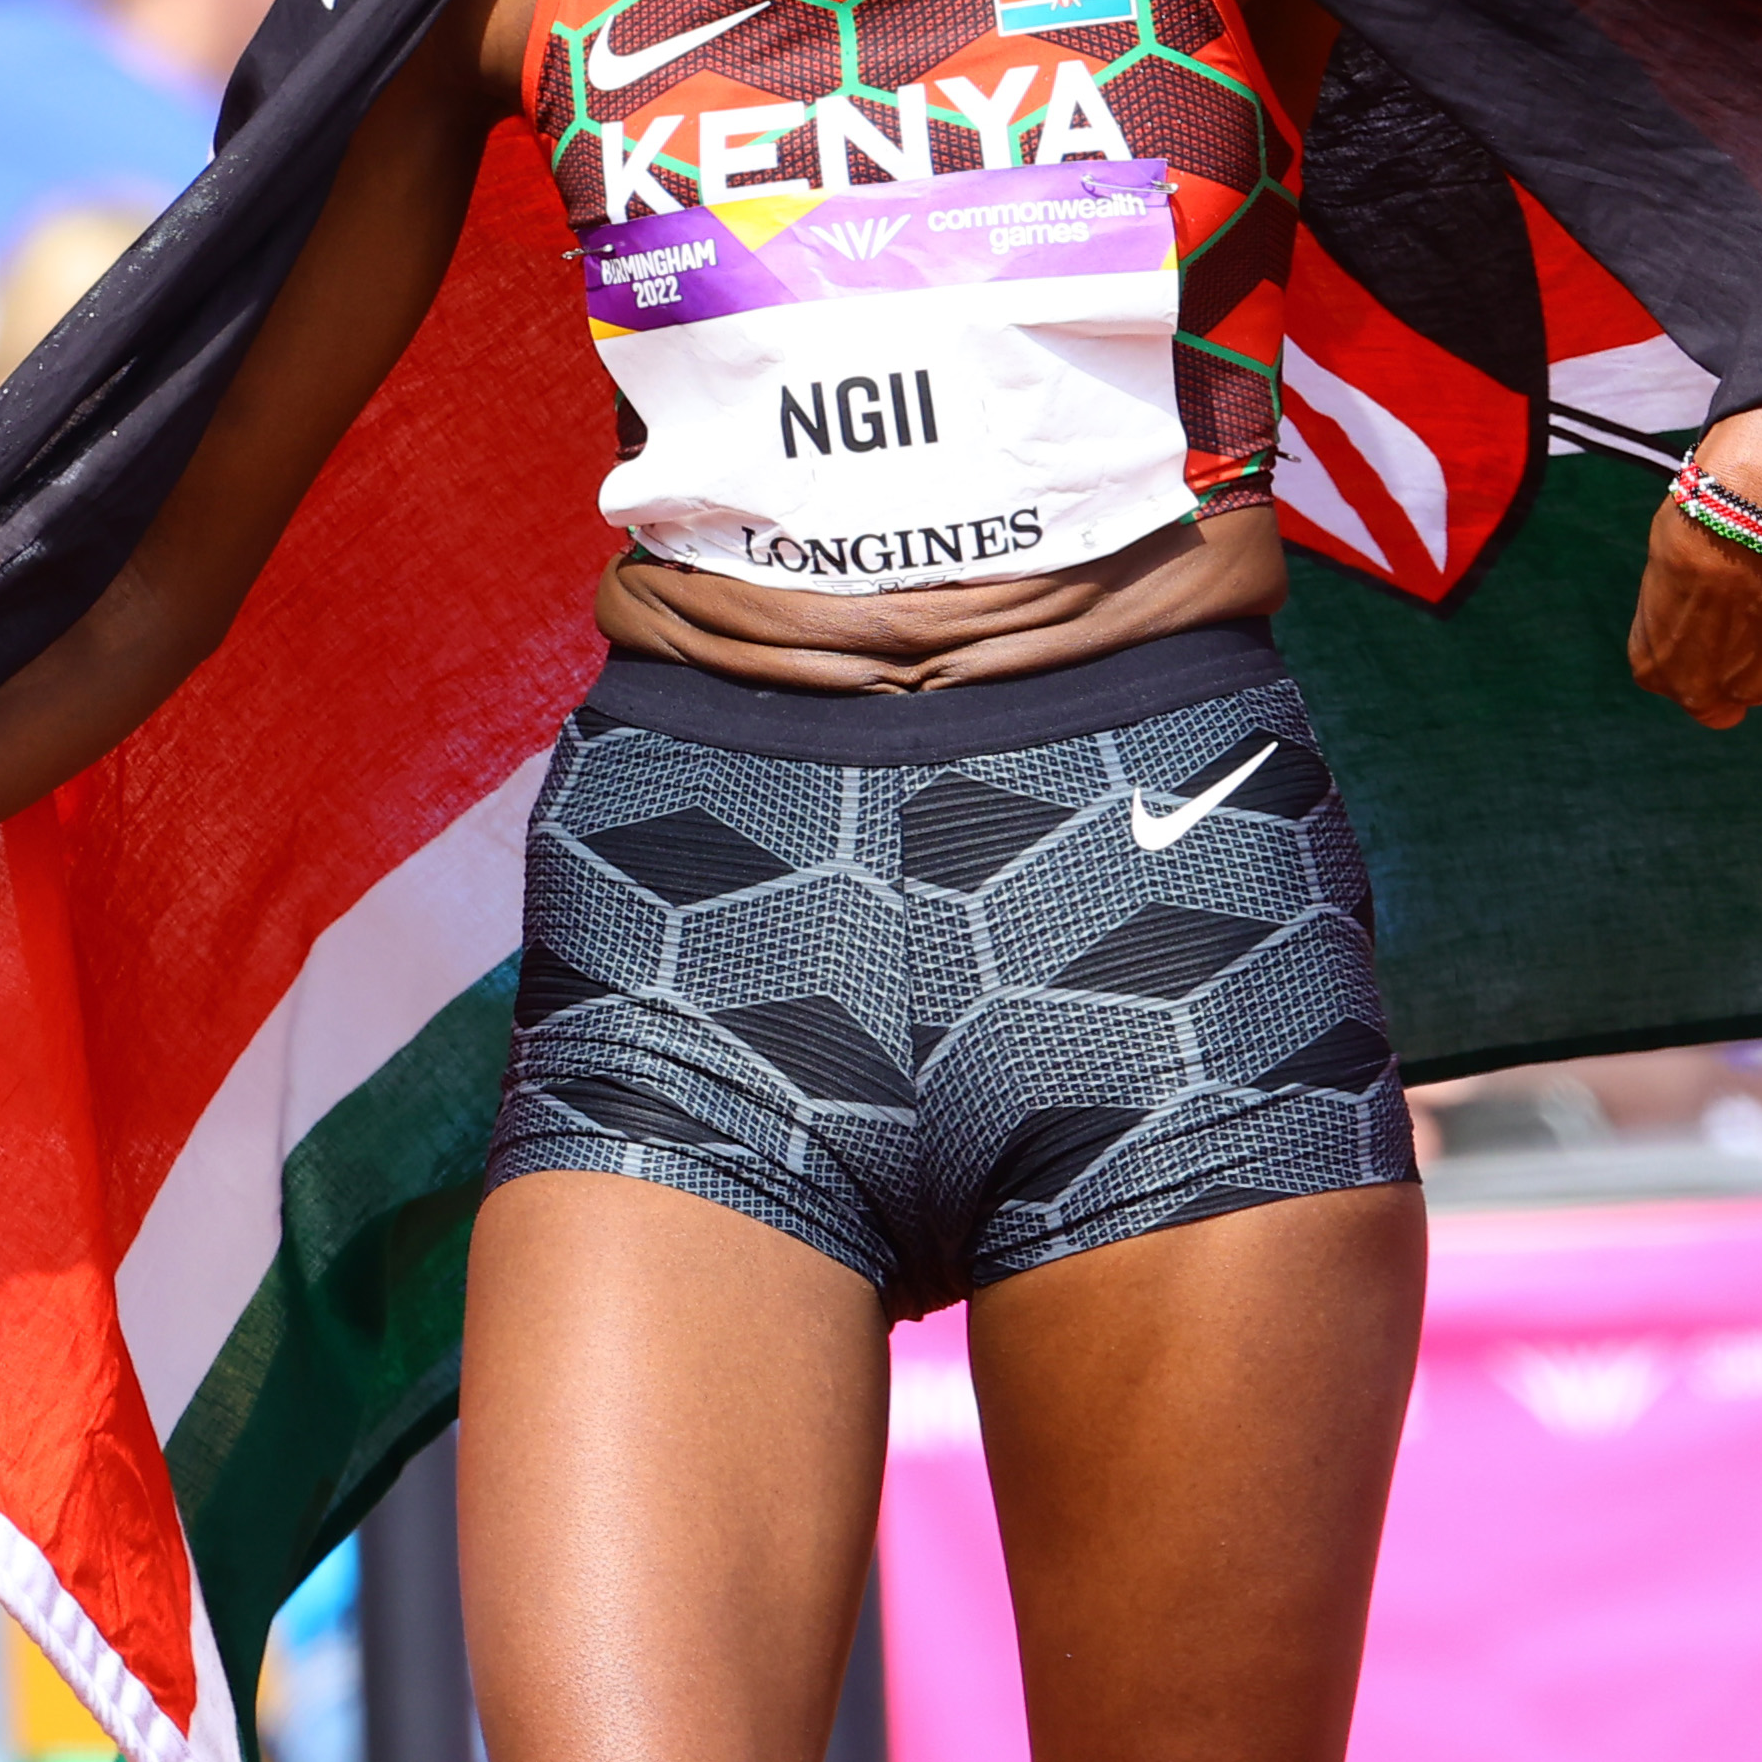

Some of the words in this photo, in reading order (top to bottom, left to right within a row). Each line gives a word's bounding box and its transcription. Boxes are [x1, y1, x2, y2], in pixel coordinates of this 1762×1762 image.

[601, 59, 1133, 225] KENYA
[927, 193, 1147, 232] commonwealth
[601, 238, 718, 286] BIRMINGHAM
[989, 222, 1090, 255] games
[632, 275, 683, 309] 2022
[780, 369, 939, 459] NGII
[741, 506, 1044, 576] LONGINES
